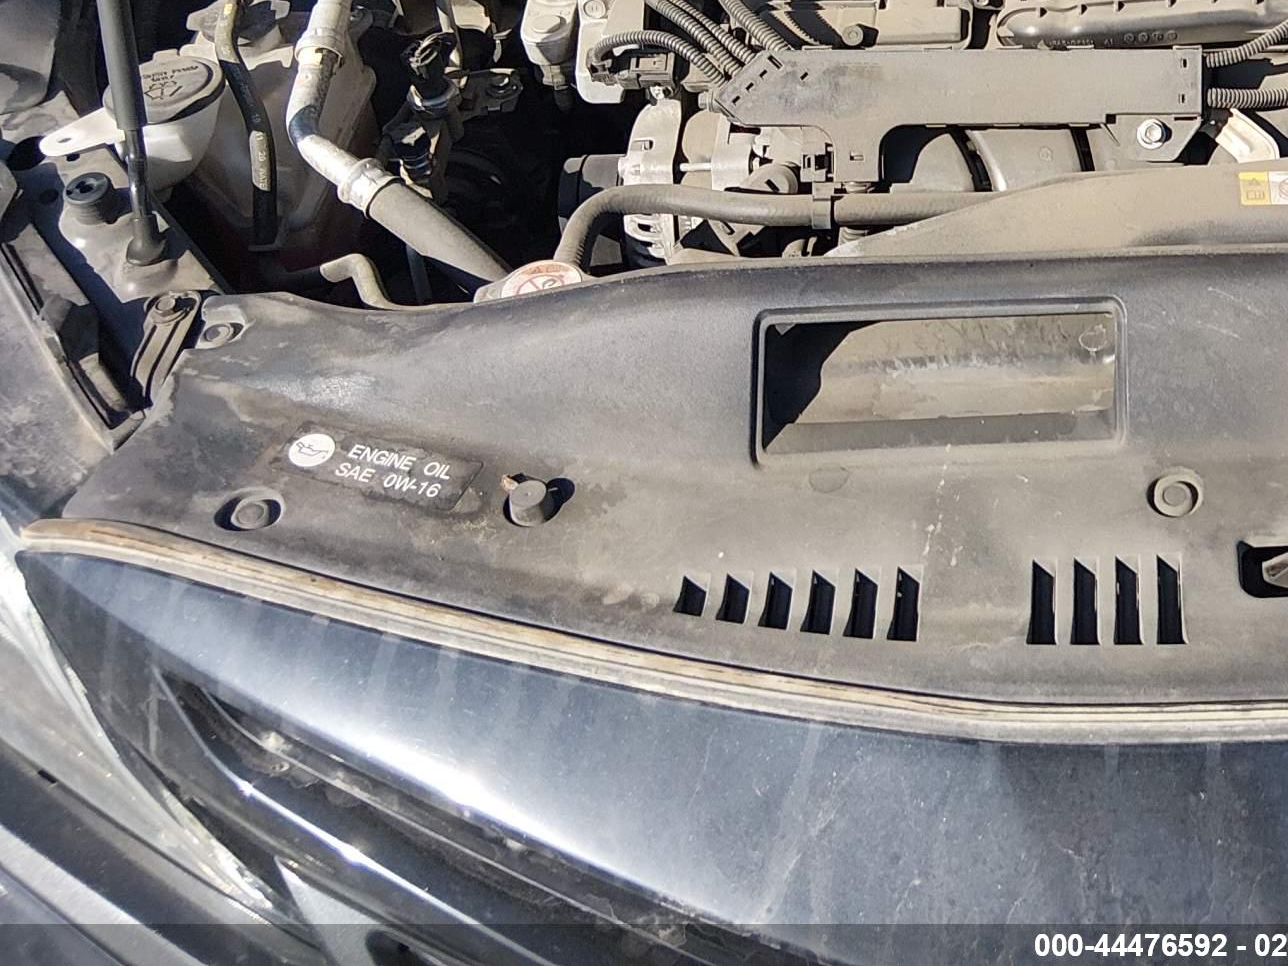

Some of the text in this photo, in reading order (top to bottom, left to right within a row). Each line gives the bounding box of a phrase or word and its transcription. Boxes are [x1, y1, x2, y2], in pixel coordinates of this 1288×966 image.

[335, 462, 441, 498] SAE 0W-16
[348, 444, 450, 480] ENGINE OIL
